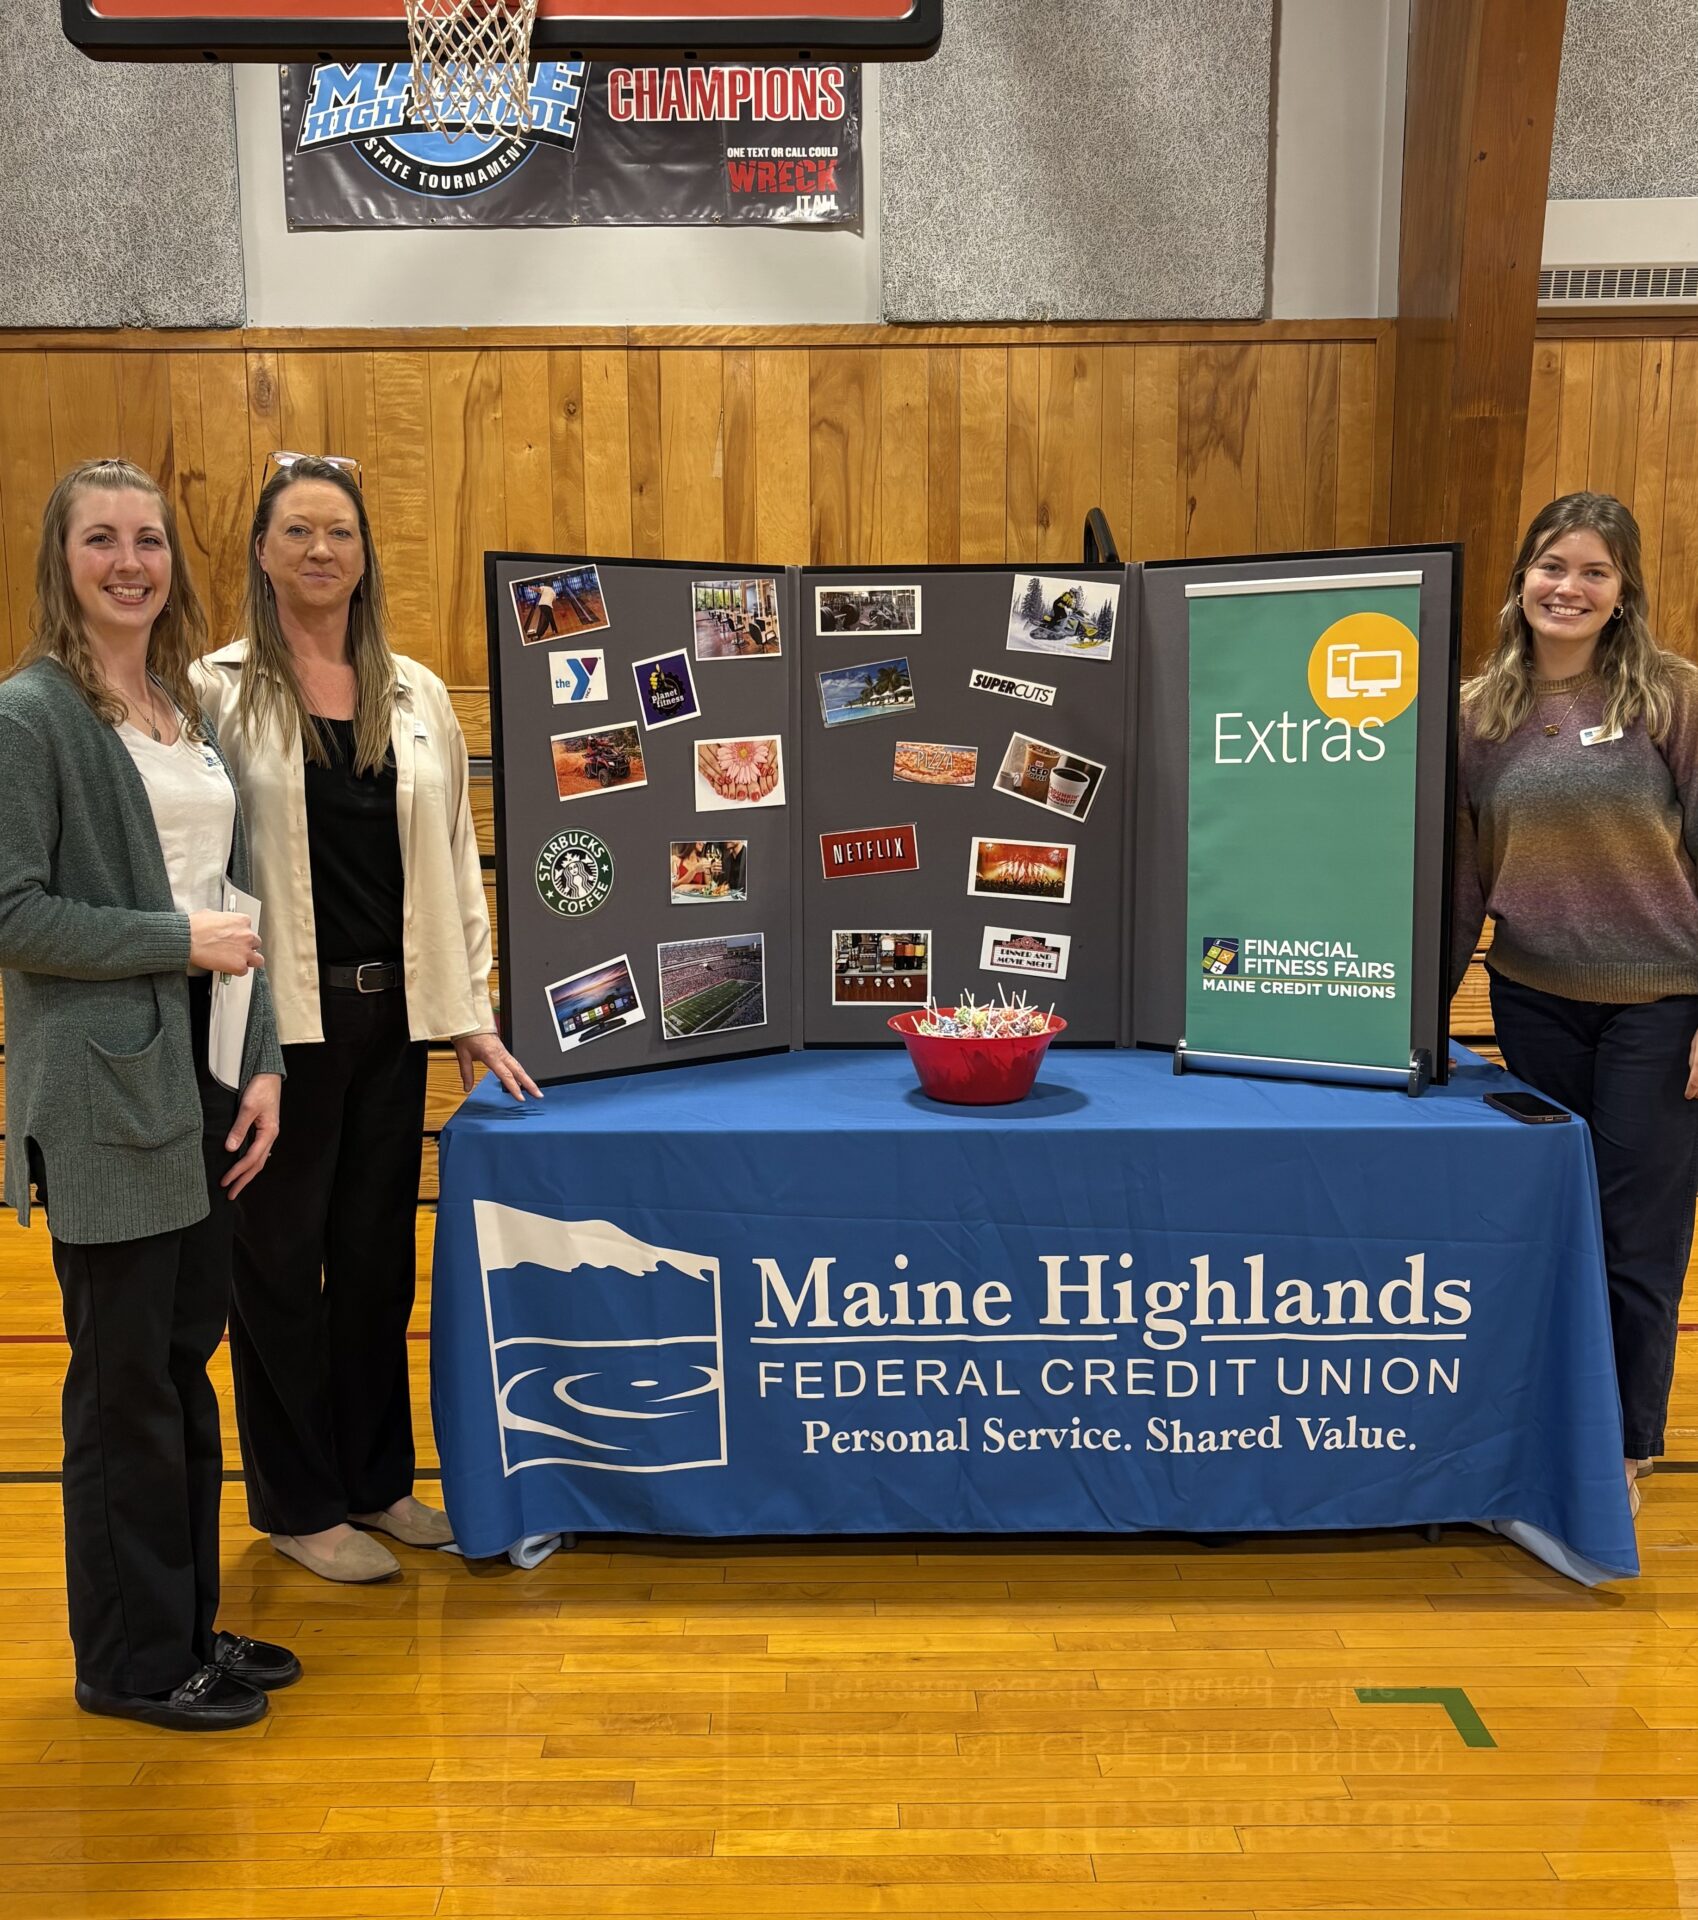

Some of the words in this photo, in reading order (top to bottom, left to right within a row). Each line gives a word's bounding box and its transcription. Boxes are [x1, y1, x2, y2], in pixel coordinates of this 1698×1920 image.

[608, 67, 845, 121] CHAMPIONS
[301, 97, 404, 146] HIGH
[727, 147, 745, 157] ONE
[747, 147, 769, 157] TEXT
[771, 147, 784, 157] OR
[785, 147, 808, 157] CALL
[809, 147, 838, 157] COULD
[364, 137, 410, 180] STATE
[418, 139, 527, 190] TOURNAMENT
[728, 160, 838, 193] WRECK
[796, 195, 811, 211] IT
[555, 678, 571, 689] the
[652, 688, 678, 704] planet
[656, 695, 685, 708] fitness
[1215, 711, 1386, 763] Extras
[914, 750, 954, 770] PIZZA
[1027, 765, 1050, 776] ICED
[539, 833, 605, 881] STARBUCKS
[833, 837, 904, 865] NETFLIX
[558, 881, 609, 913] COFFEE
[1000, 948, 1033, 959] DINNER
[1034, 953, 1052, 961] AND
[1244, 939, 1358, 958] FINANCIAL
[996, 956, 1024, 966] MOVIE
[1026, 960, 1053, 969] NIGHT
[1244, 958, 1328, 976] FITNESS
[1334, 961, 1395, 979] FAIRS
[1203, 979, 1256, 993] MAINE
[1260, 981, 1323, 995] CREDIT
[1327, 984, 1396, 999] UNIONS
[752, 1253, 1013, 1328] Maine
[1038, 1252, 1473, 1351] Highlands
[758, 1359, 1022, 1399] FEDERAL
[1040, 1357, 1257, 1398] CREDIT
[1277, 1356, 1460, 1396] UNION
[801, 1417, 970, 1454] Personal
[983, 1416, 1132, 1454] Service.
[1145, 1415, 1283, 1454] Shared
[1295, 1414, 1417, 1451] Value.
